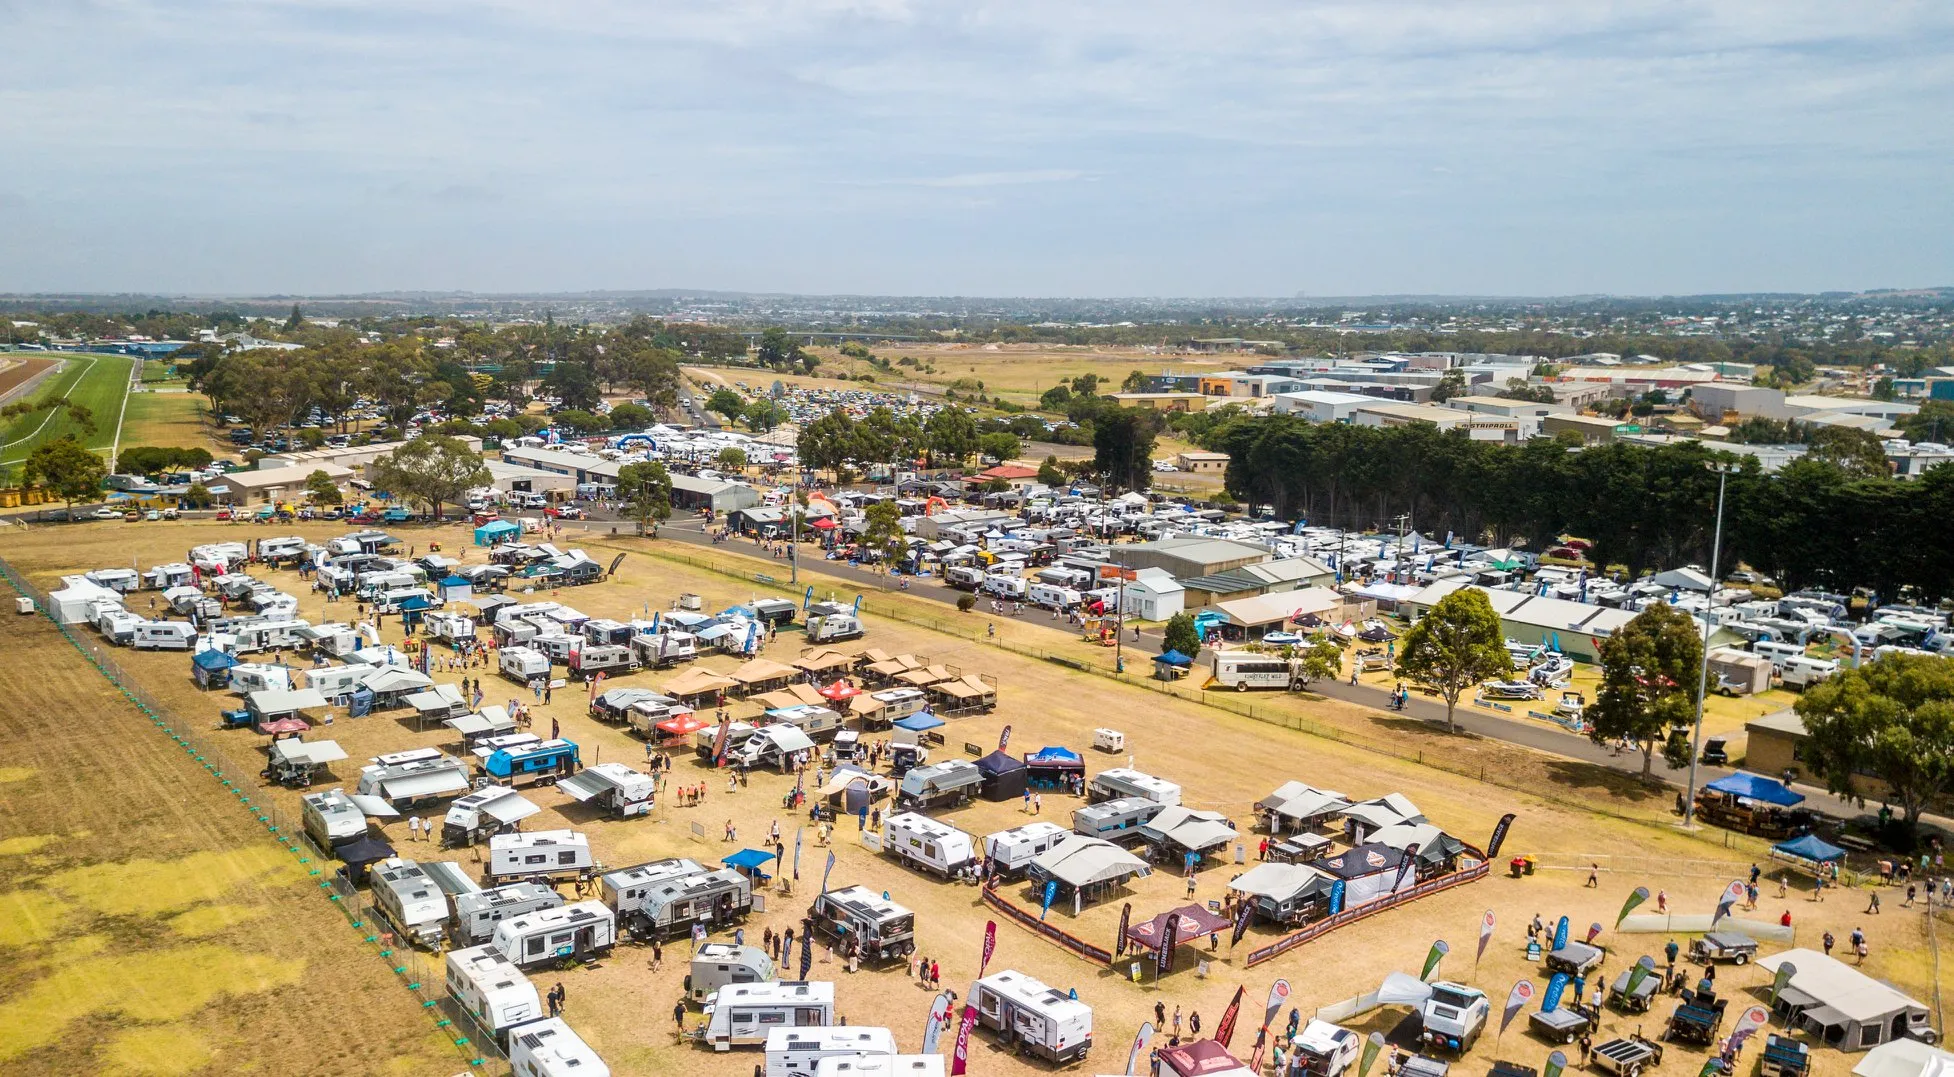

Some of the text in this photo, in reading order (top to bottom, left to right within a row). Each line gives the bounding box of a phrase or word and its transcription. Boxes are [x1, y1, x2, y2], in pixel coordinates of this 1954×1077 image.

[984, 931, 993, 954] OPAL
[1160, 928, 1171, 968] LUMBERJACK
[958, 1017, 971, 1046] OPAL
[1217, 1002, 1240, 1041] ENGEL
